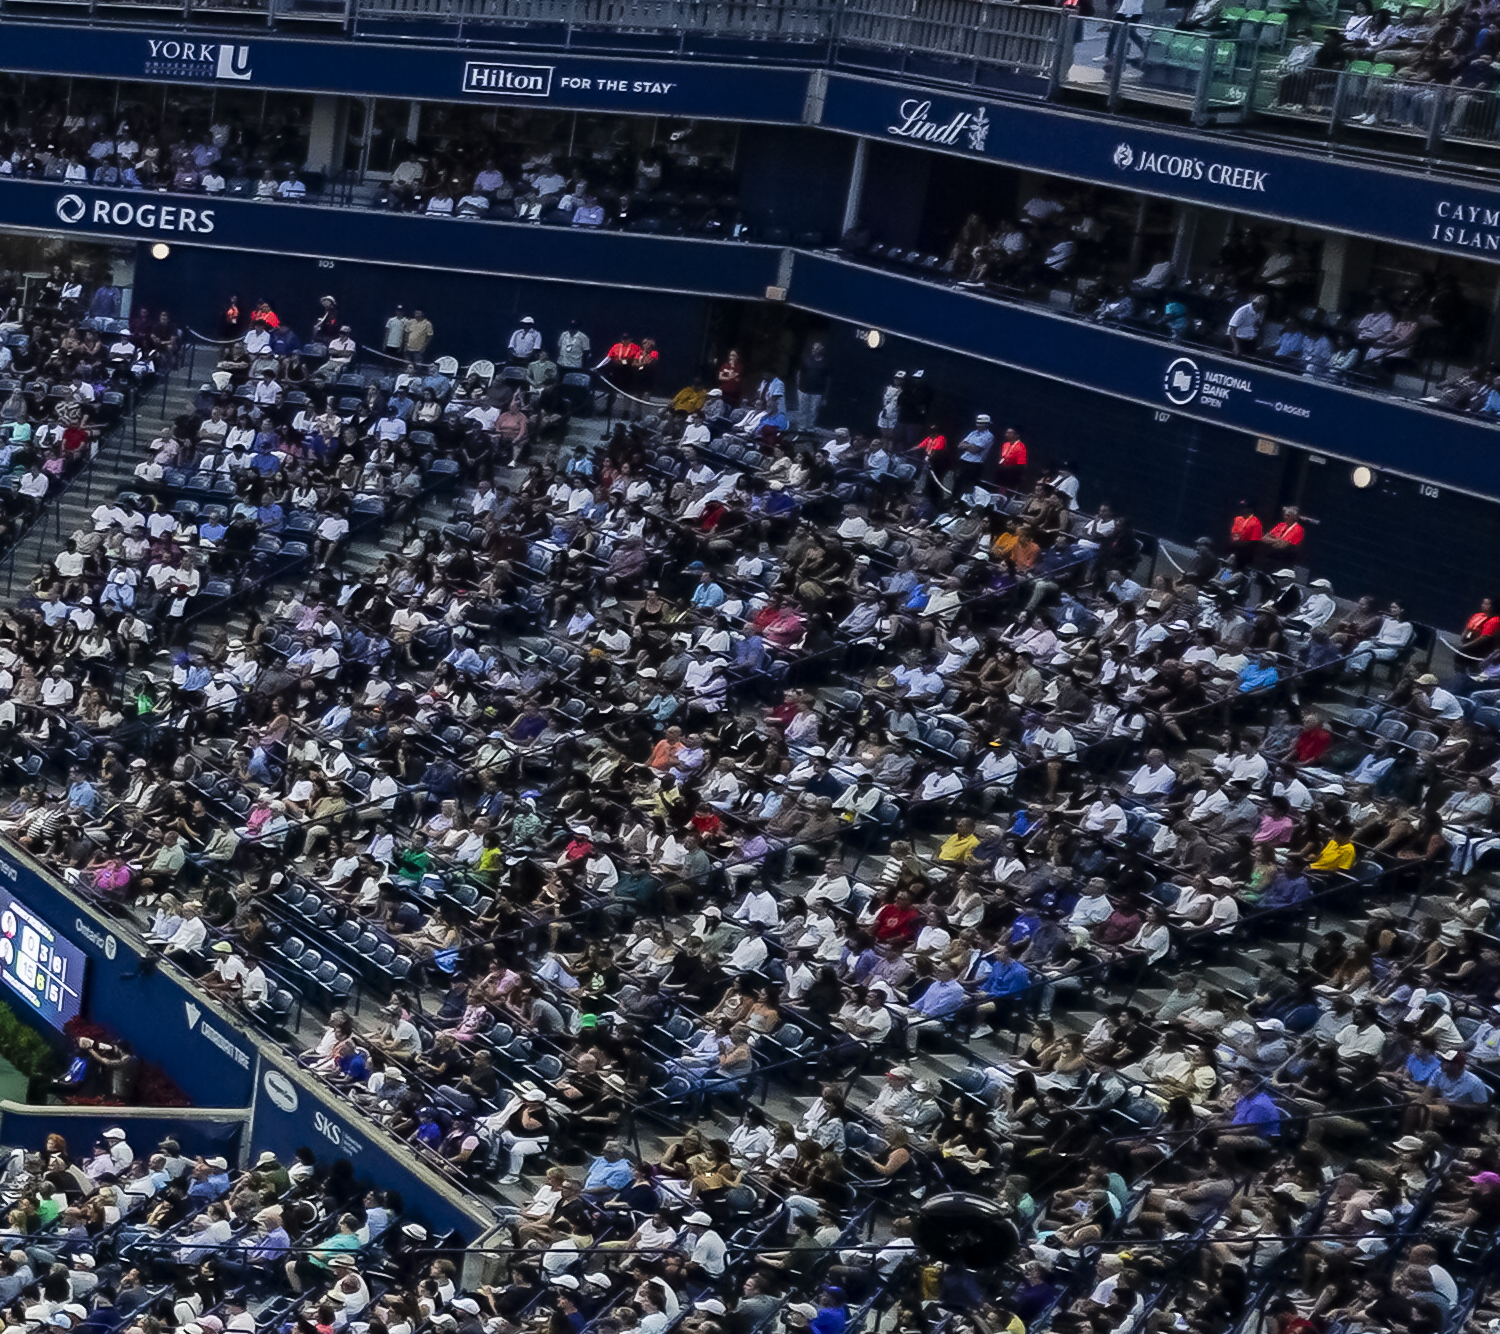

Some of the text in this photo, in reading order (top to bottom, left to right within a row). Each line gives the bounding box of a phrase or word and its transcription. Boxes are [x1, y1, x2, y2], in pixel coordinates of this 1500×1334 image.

[148, 39, 216, 63] YORK
[470, 69, 671, 95] Hilton FOR THE STAY
[888, 98, 972, 146] Lindt
[1135, 151, 1269, 192] JACOB'S CREEK
[93, 200, 217, 234] ROGERS
[1202, 383, 1230, 400] BANK
[1204, 370, 1253, 393] NATIONAL
[39, 942, 49, 962] 3
[313, 1110, 342, 1145] SKS
